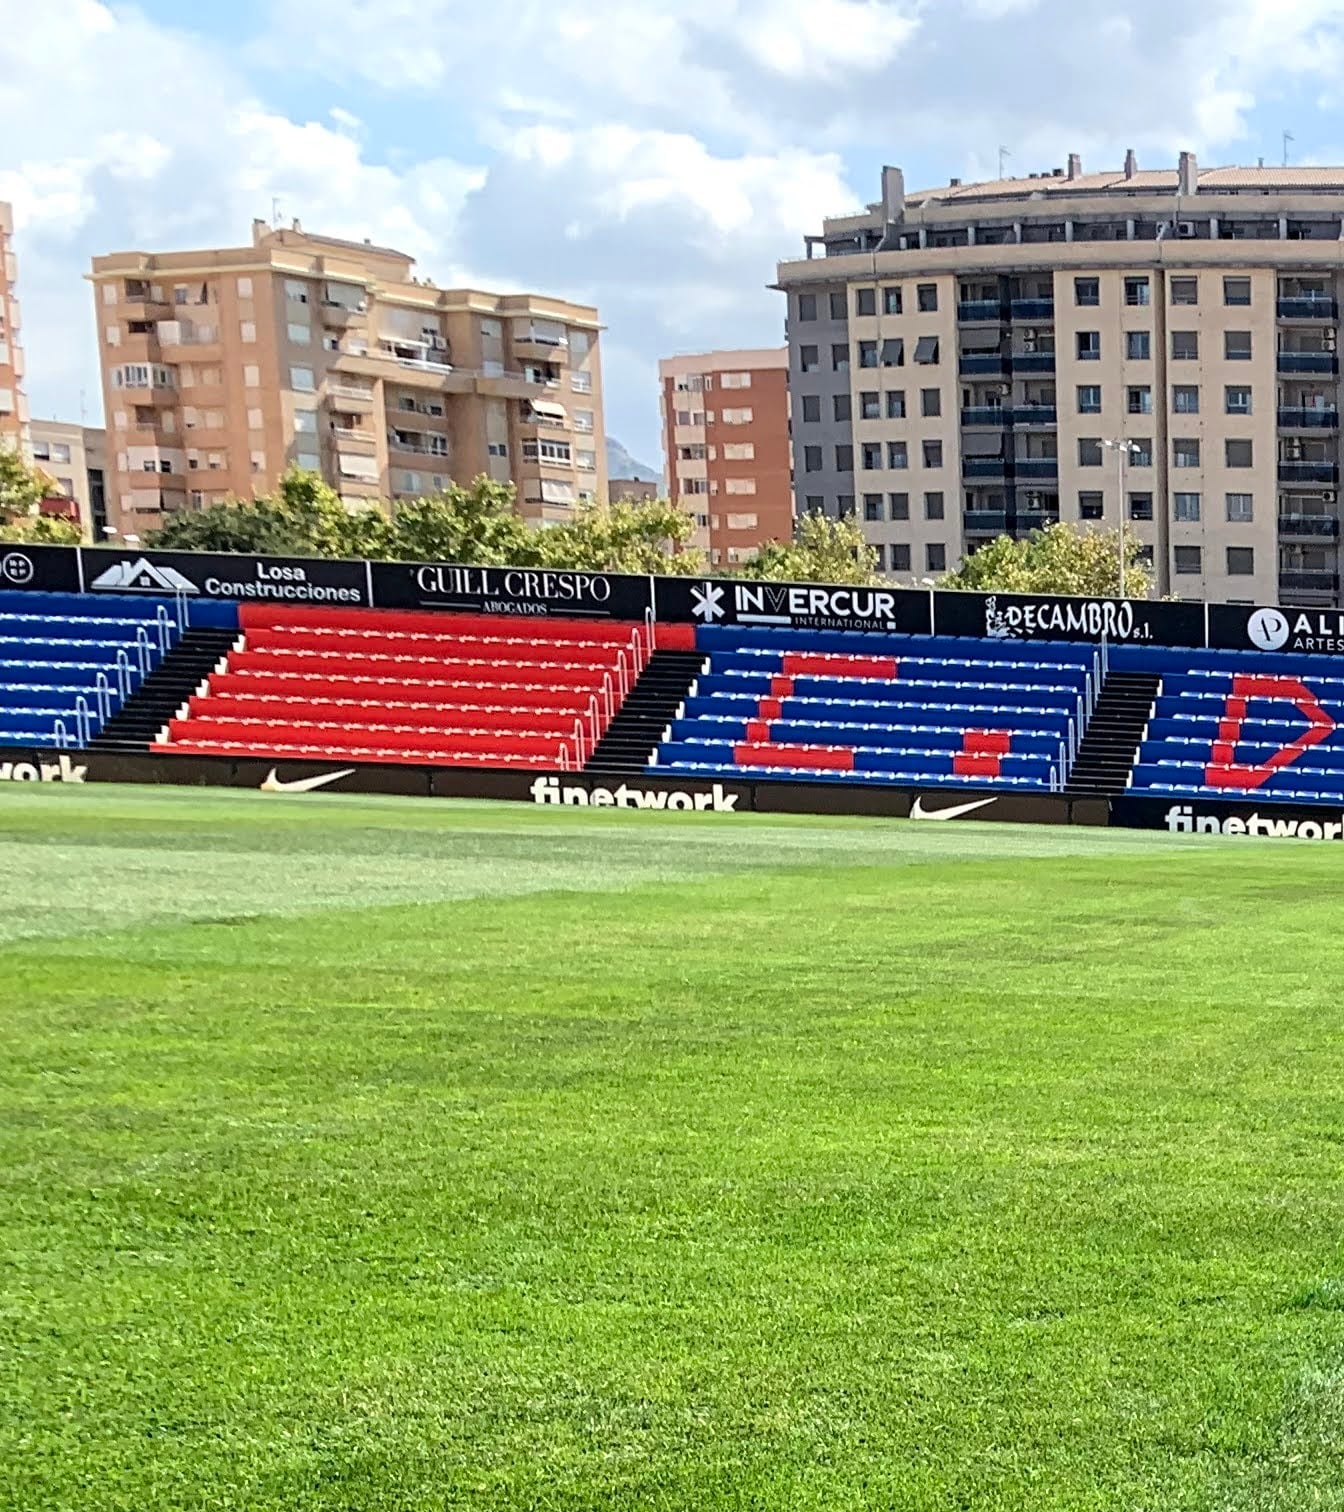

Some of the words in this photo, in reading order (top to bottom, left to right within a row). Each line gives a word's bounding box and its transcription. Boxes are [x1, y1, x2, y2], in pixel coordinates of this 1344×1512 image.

[256, 562, 306, 581] Losa
[205, 577, 361, 601] Construcciones
[417, 567, 499, 595] GUILL
[505, 572, 611, 601] CRESPO
[483, 601, 547, 615] ABOGADOS
[735, 585, 895, 619] INVERCUR
[795, 617, 884, 630] INTERNATIONAL
[1294, 637, 1344, 651] ARTES
[530, 776, 738, 812] finetwork
